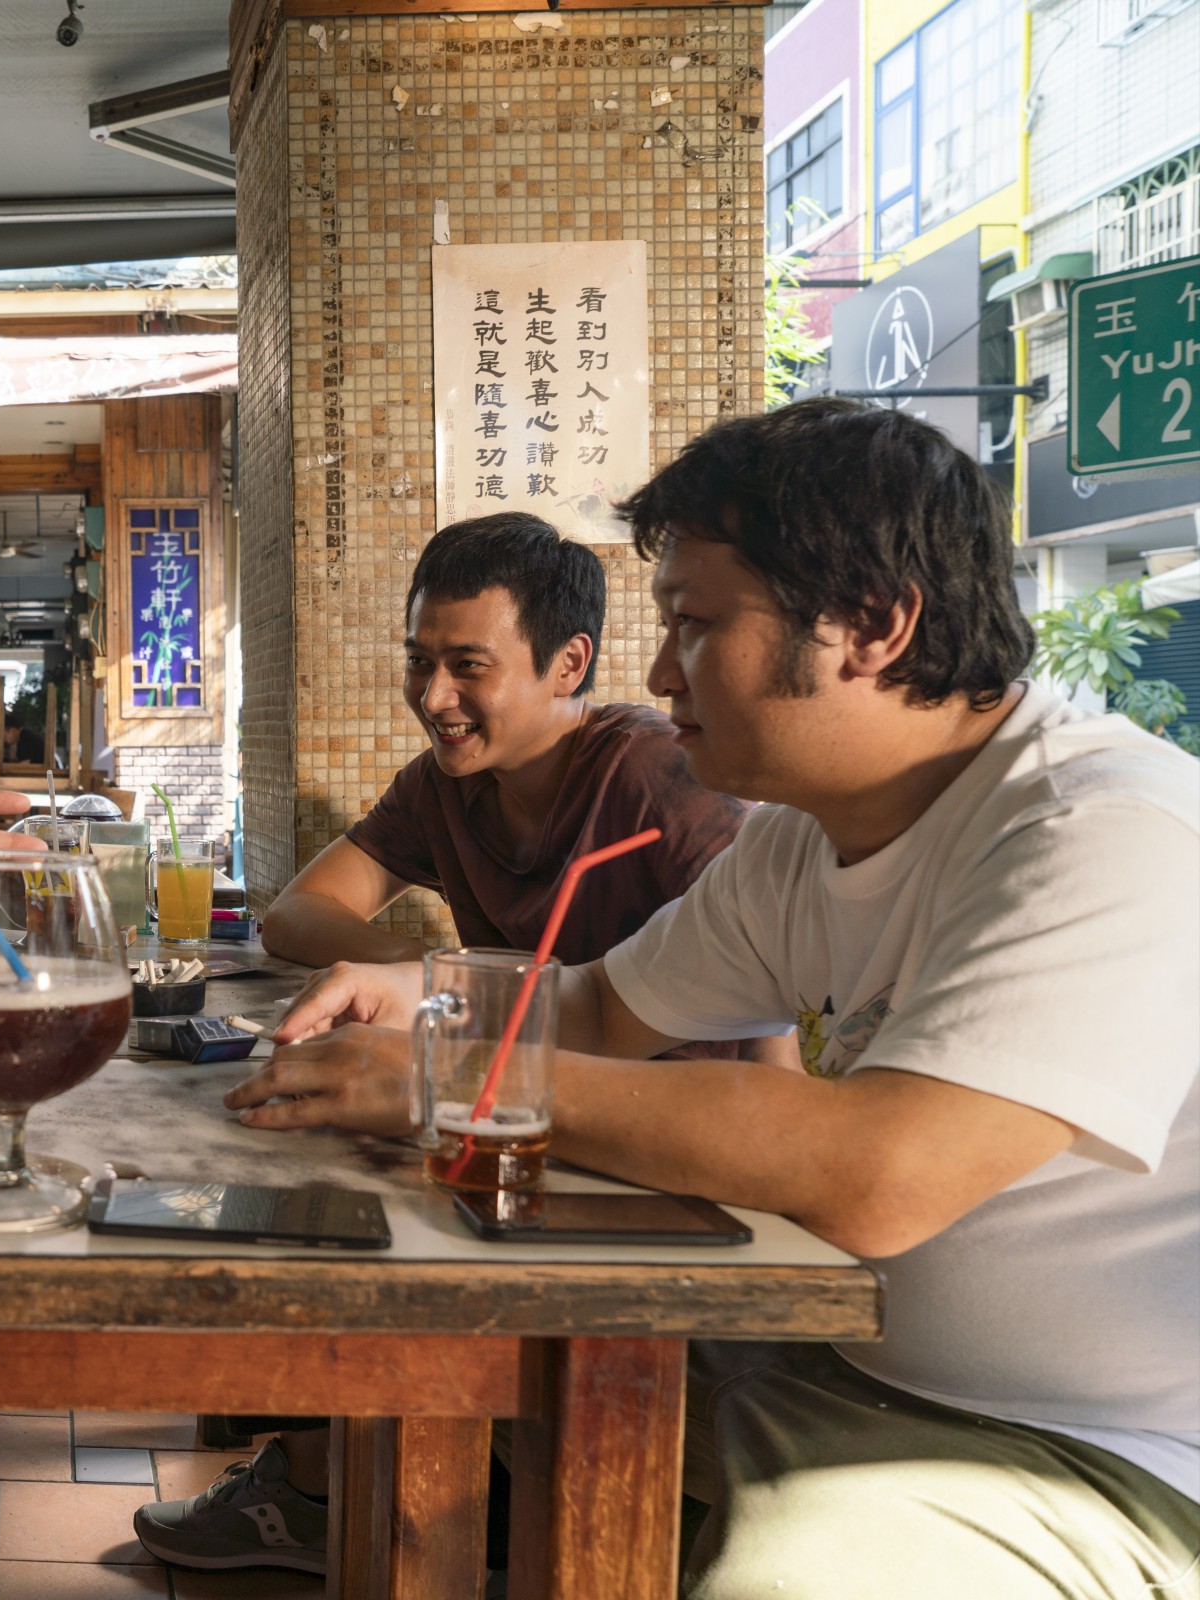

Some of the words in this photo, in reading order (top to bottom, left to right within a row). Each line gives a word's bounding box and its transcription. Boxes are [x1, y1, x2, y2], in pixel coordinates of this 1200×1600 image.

[472, 288, 509, 500] 這就是隨喜功德
[524, 287, 560, 497] 生起歡喜心讚歎
[576, 287, 610, 466] 看到別人成功
[1161, 377, 1192, 444] 2
[150, 532, 182, 611] 玉竹軒
